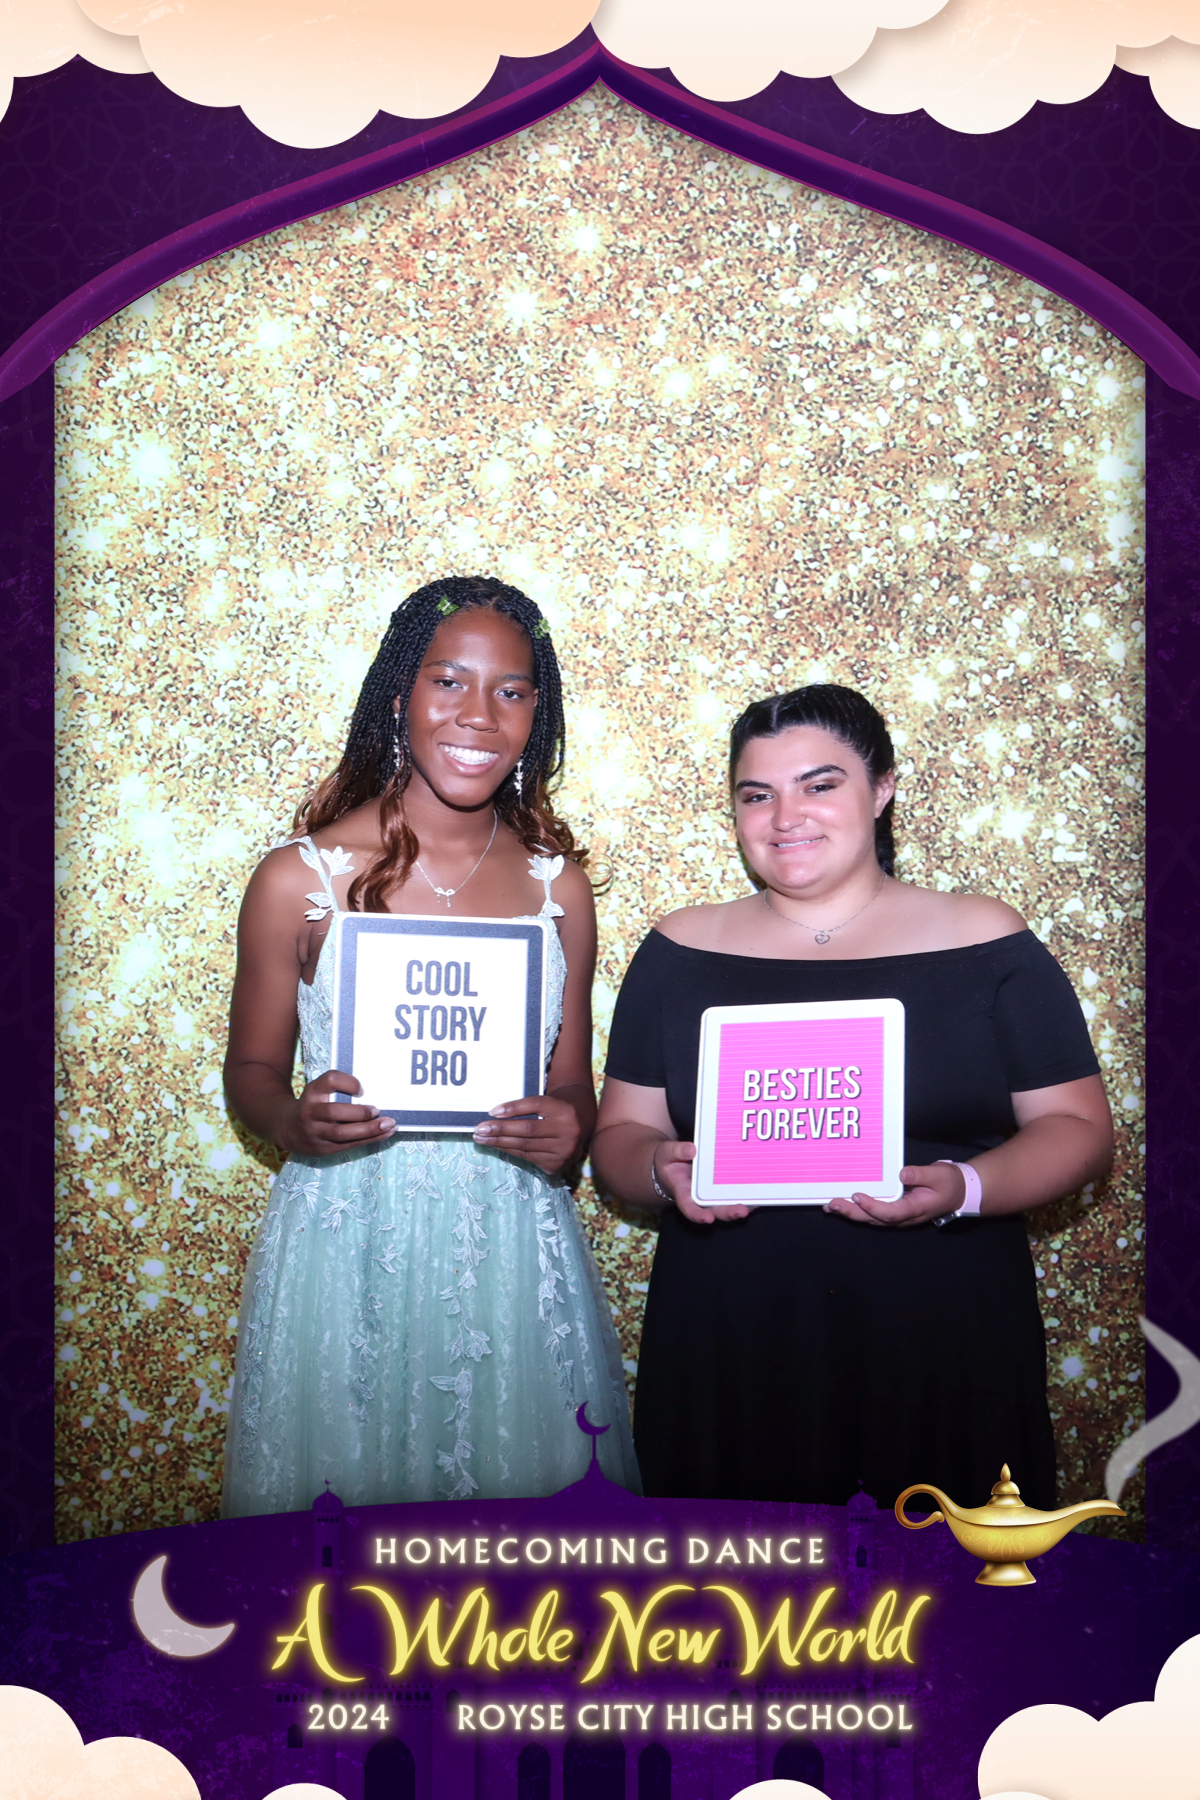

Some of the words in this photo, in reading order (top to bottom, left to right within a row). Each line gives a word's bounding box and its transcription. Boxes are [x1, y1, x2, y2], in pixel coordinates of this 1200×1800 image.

[405, 960, 479, 997] COOL
[393, 1003, 488, 1042] STORY
[411, 1049, 468, 1087] BRO
[742, 1065, 862, 1102] BESTIES
[740, 1106, 861, 1141] FOREVER
